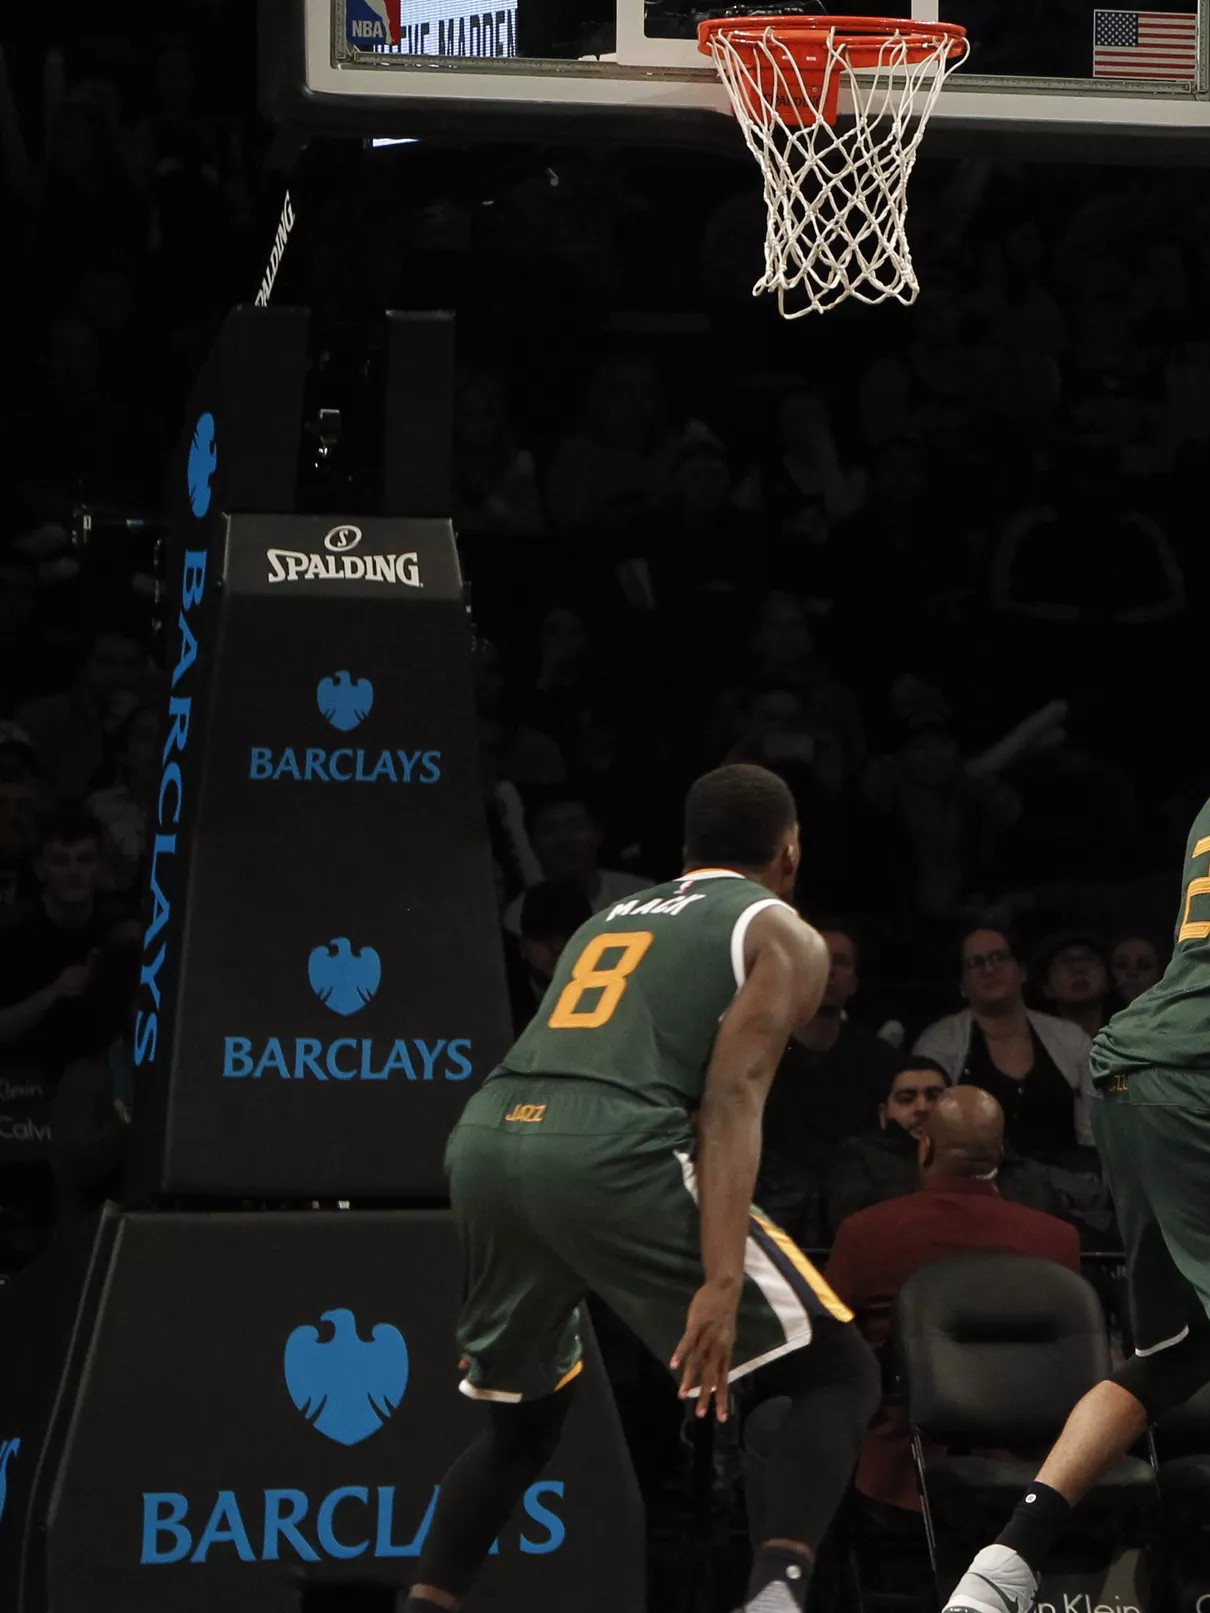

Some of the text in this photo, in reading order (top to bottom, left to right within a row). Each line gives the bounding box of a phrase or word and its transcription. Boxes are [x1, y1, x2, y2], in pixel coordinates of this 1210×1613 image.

[352, 20, 384, 38] NBA
[266, 548, 422, 588] SPALDING
[249, 747, 441, 783] BARCLAYS
[134, 549, 207, 1067] BARCLAYS
[548, 931, 653, 1028] 8
[222, 1036, 473, 1082] BARCLAYS
[139, 1480, 566, 1565] BARCLS
